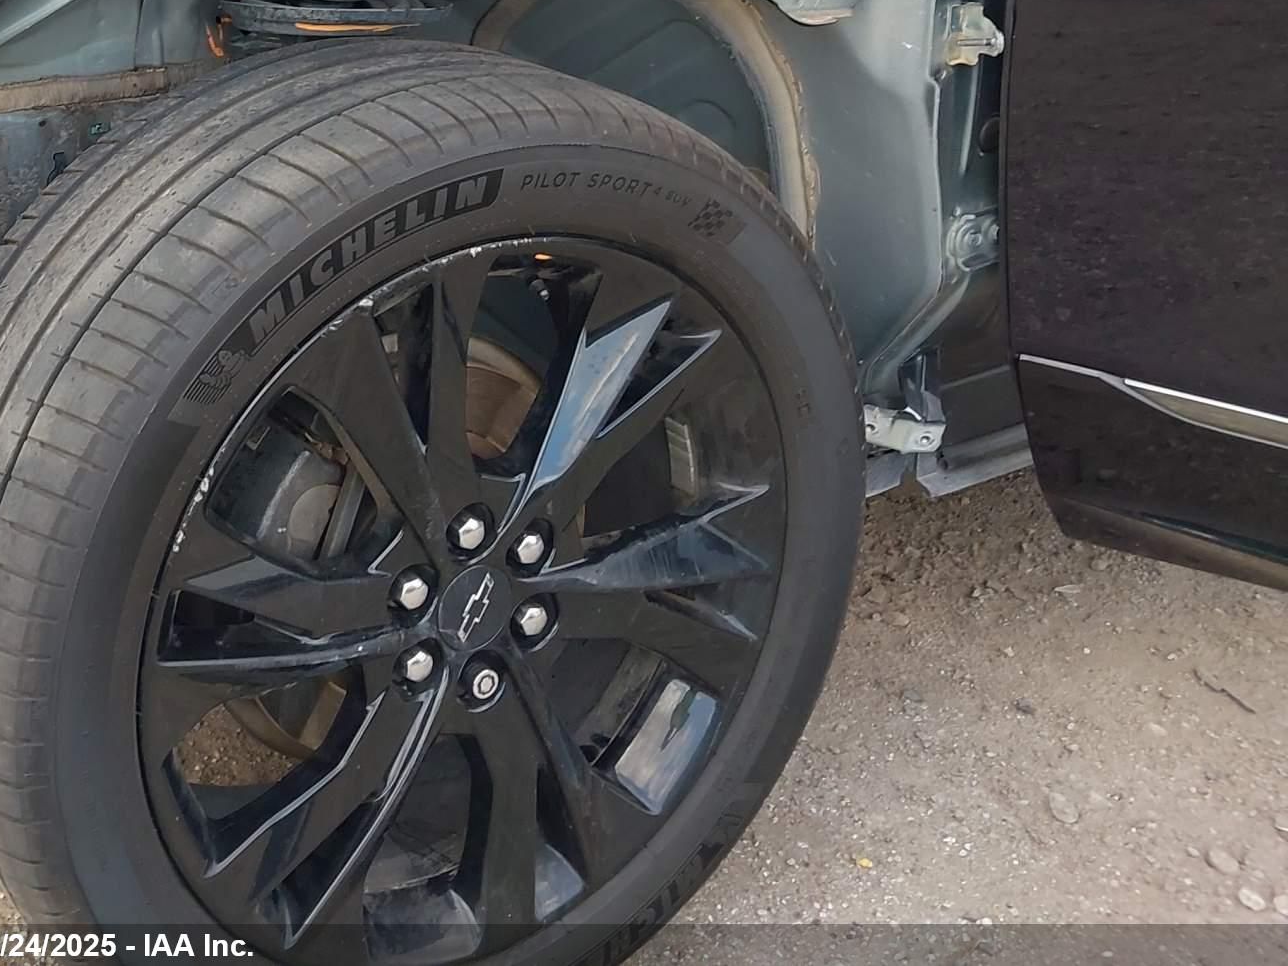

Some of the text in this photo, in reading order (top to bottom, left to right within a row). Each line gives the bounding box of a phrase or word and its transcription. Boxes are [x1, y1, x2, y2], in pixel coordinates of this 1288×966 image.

[520, 172, 581, 191] PILOT
[586, 172, 653, 197] SPORT
[248, 175, 489, 347] MICHELIN
